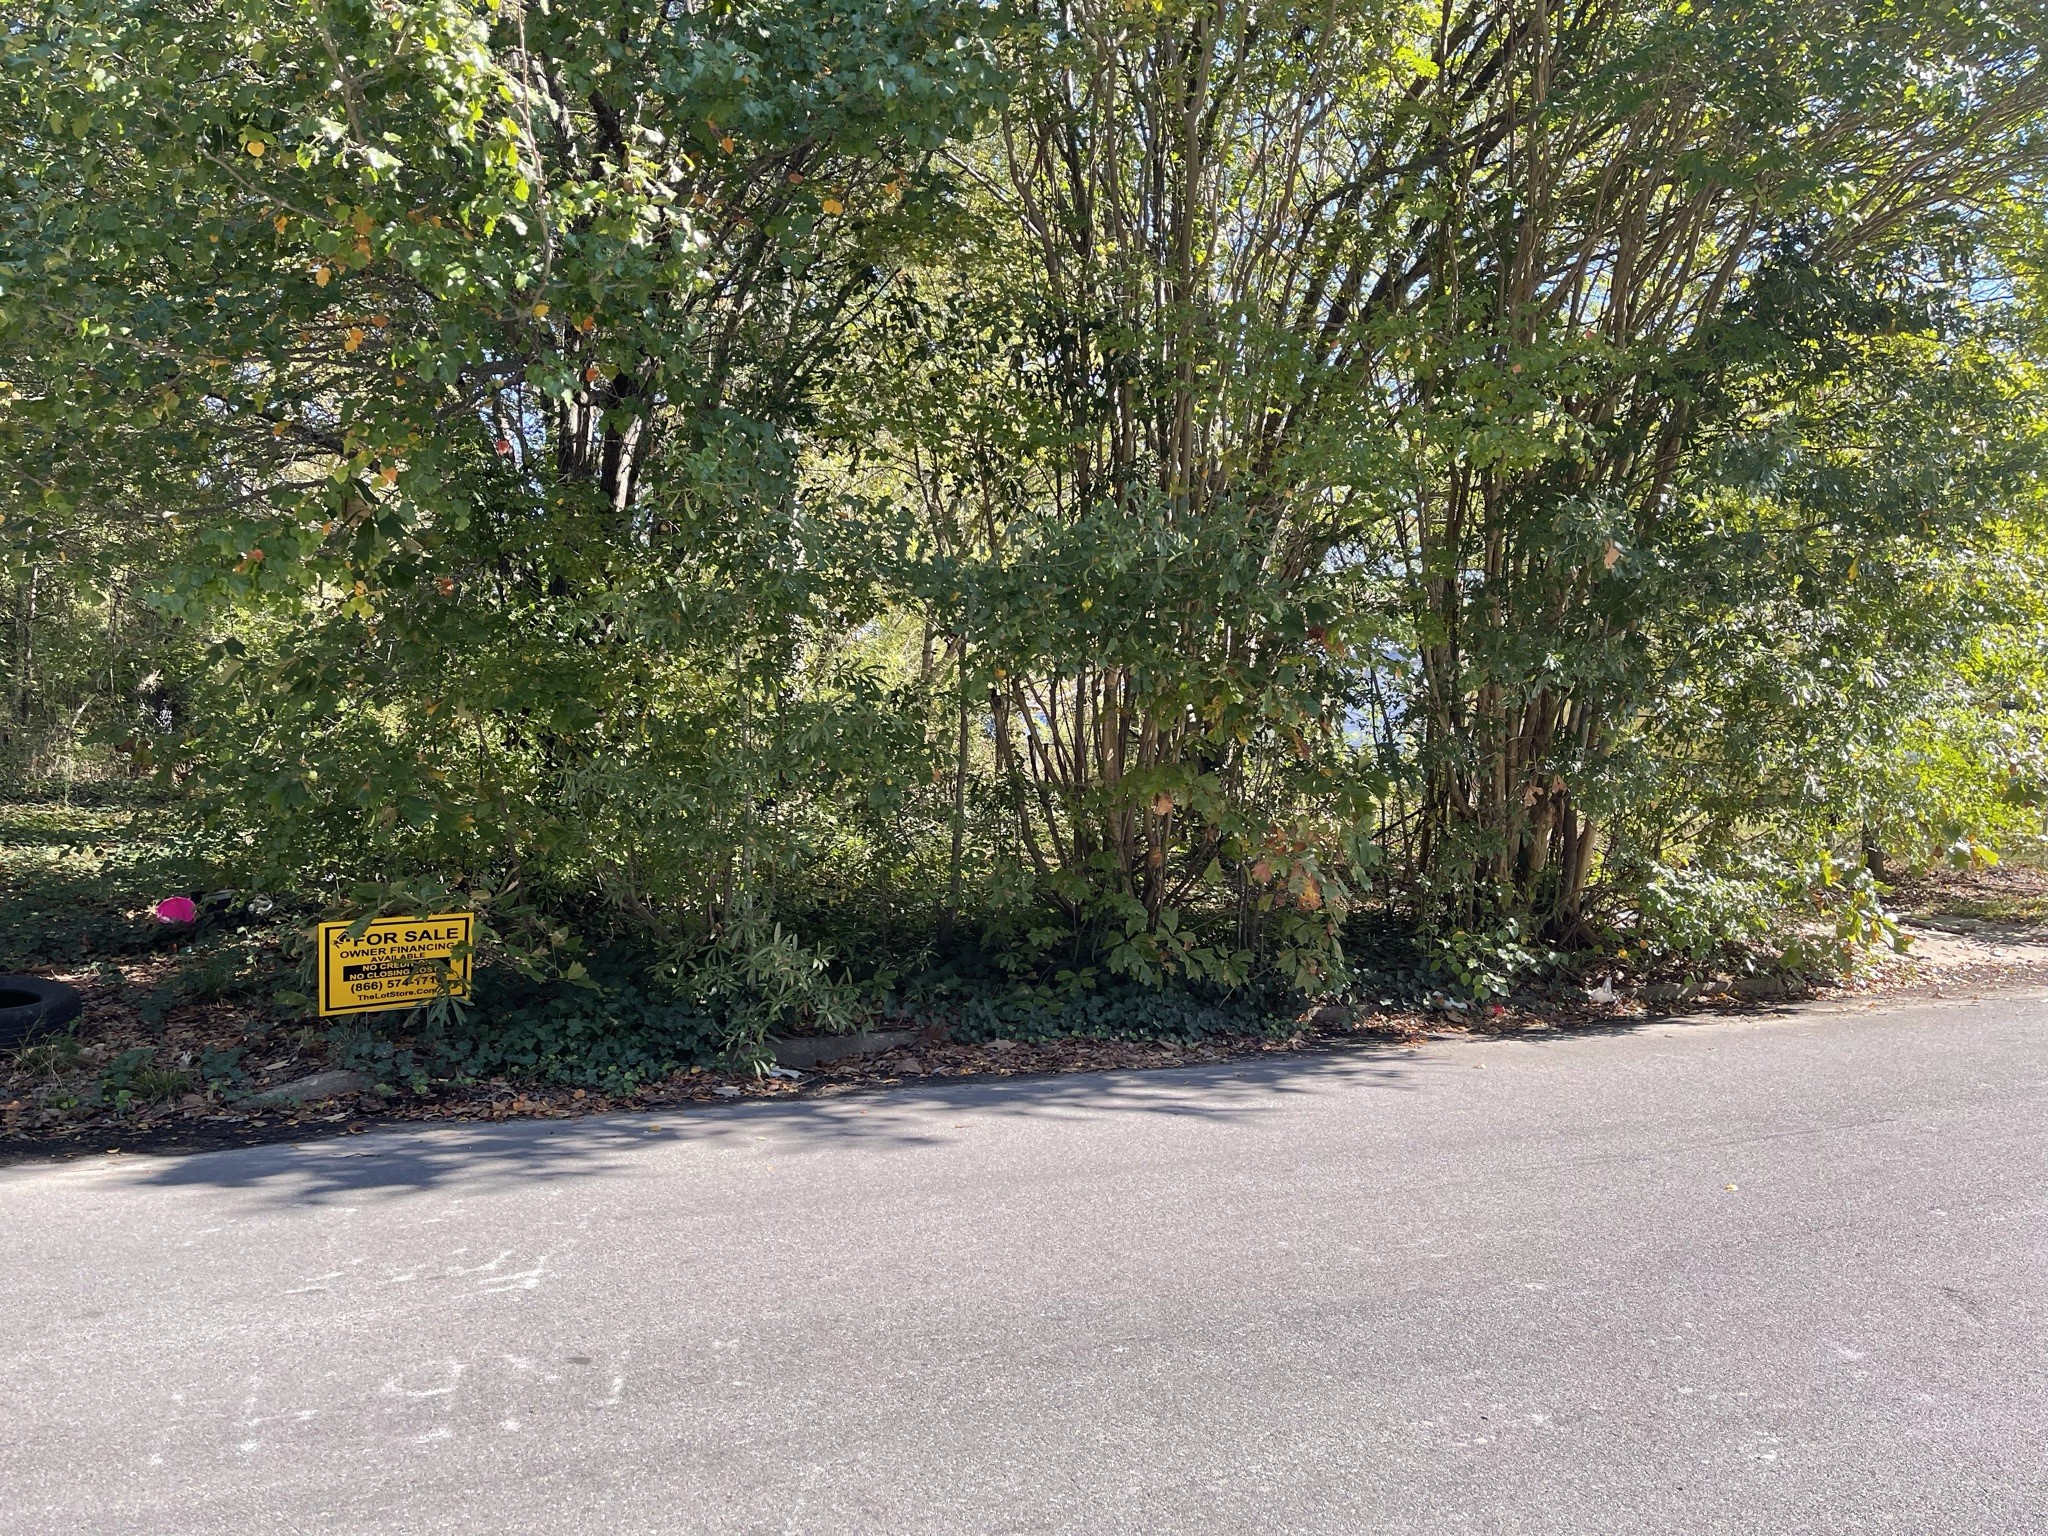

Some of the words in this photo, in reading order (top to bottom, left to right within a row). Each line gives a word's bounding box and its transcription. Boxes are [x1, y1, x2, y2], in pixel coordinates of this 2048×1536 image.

[353, 932, 398, 947] FOR
[404, 928, 459, 942] SALE
[340, 947, 387, 959] OWNER
[370, 952, 425, 963] AVAILABLE
[362, 963, 378, 972] NO
[349, 972, 364, 981] NO
[366, 968, 410, 979] CLOSING
[350, 980, 383, 994] (866)
[387, 975, 439, 989] 574-171
